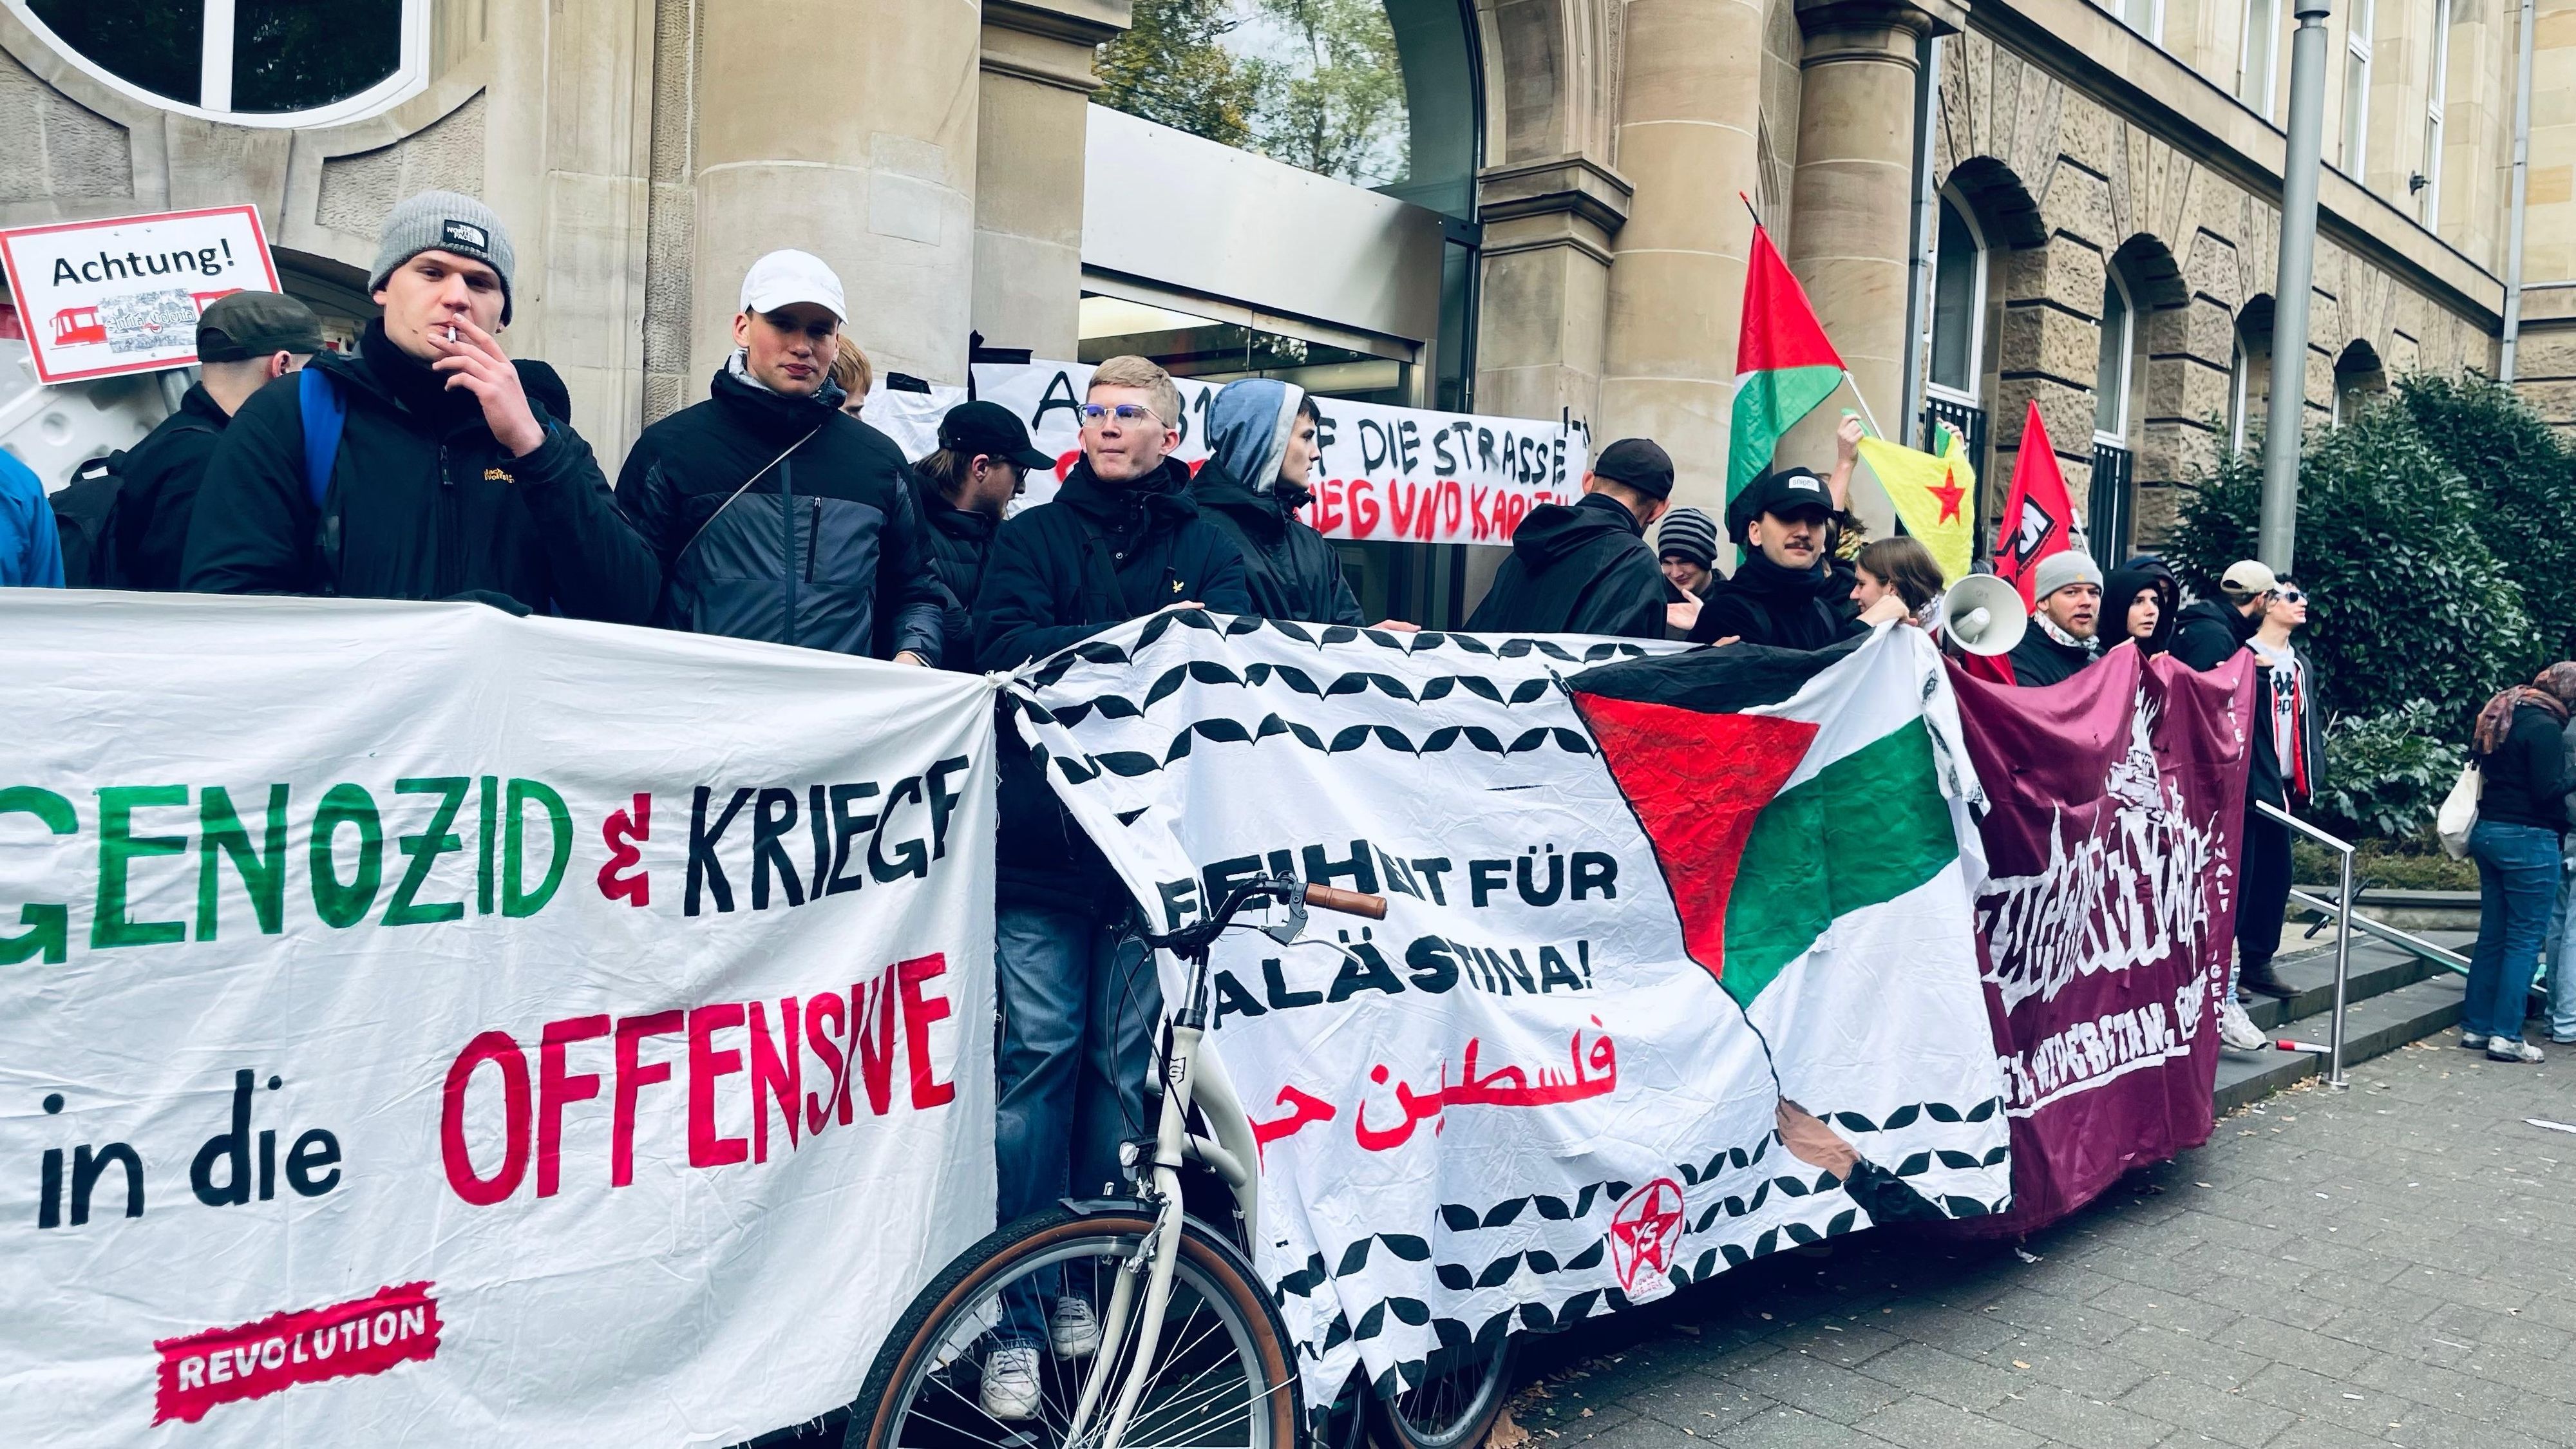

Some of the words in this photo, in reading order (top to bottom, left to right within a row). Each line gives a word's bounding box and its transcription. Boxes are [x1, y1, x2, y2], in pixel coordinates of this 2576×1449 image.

[53, 238, 234, 287] Achtung!
[447, 227, 472, 237] NORTH
[453, 232, 473, 242] FACE
[1358, 417, 1421, 476] DIE
[1432, 421, 1567, 488] STRASSE
[1388, 478, 1463, 543] UND
[0, 775, 573, 965] GENOZID
[597, 793, 651, 907] &
[1469, 842, 1618, 908] FÜR
[1204, 926, 1593, 1030] ALÄSTINA!
[37, 1093, 144, 1229] in
[189, 1068, 342, 1208] die
[440, 952, 956, 1206] OFFENSIVE
[1354, 1014, 1617, 1152] فلسطين
[1631, 1221, 1660, 1261] YS
[178, 1305, 426, 1392] REVOLUTION
